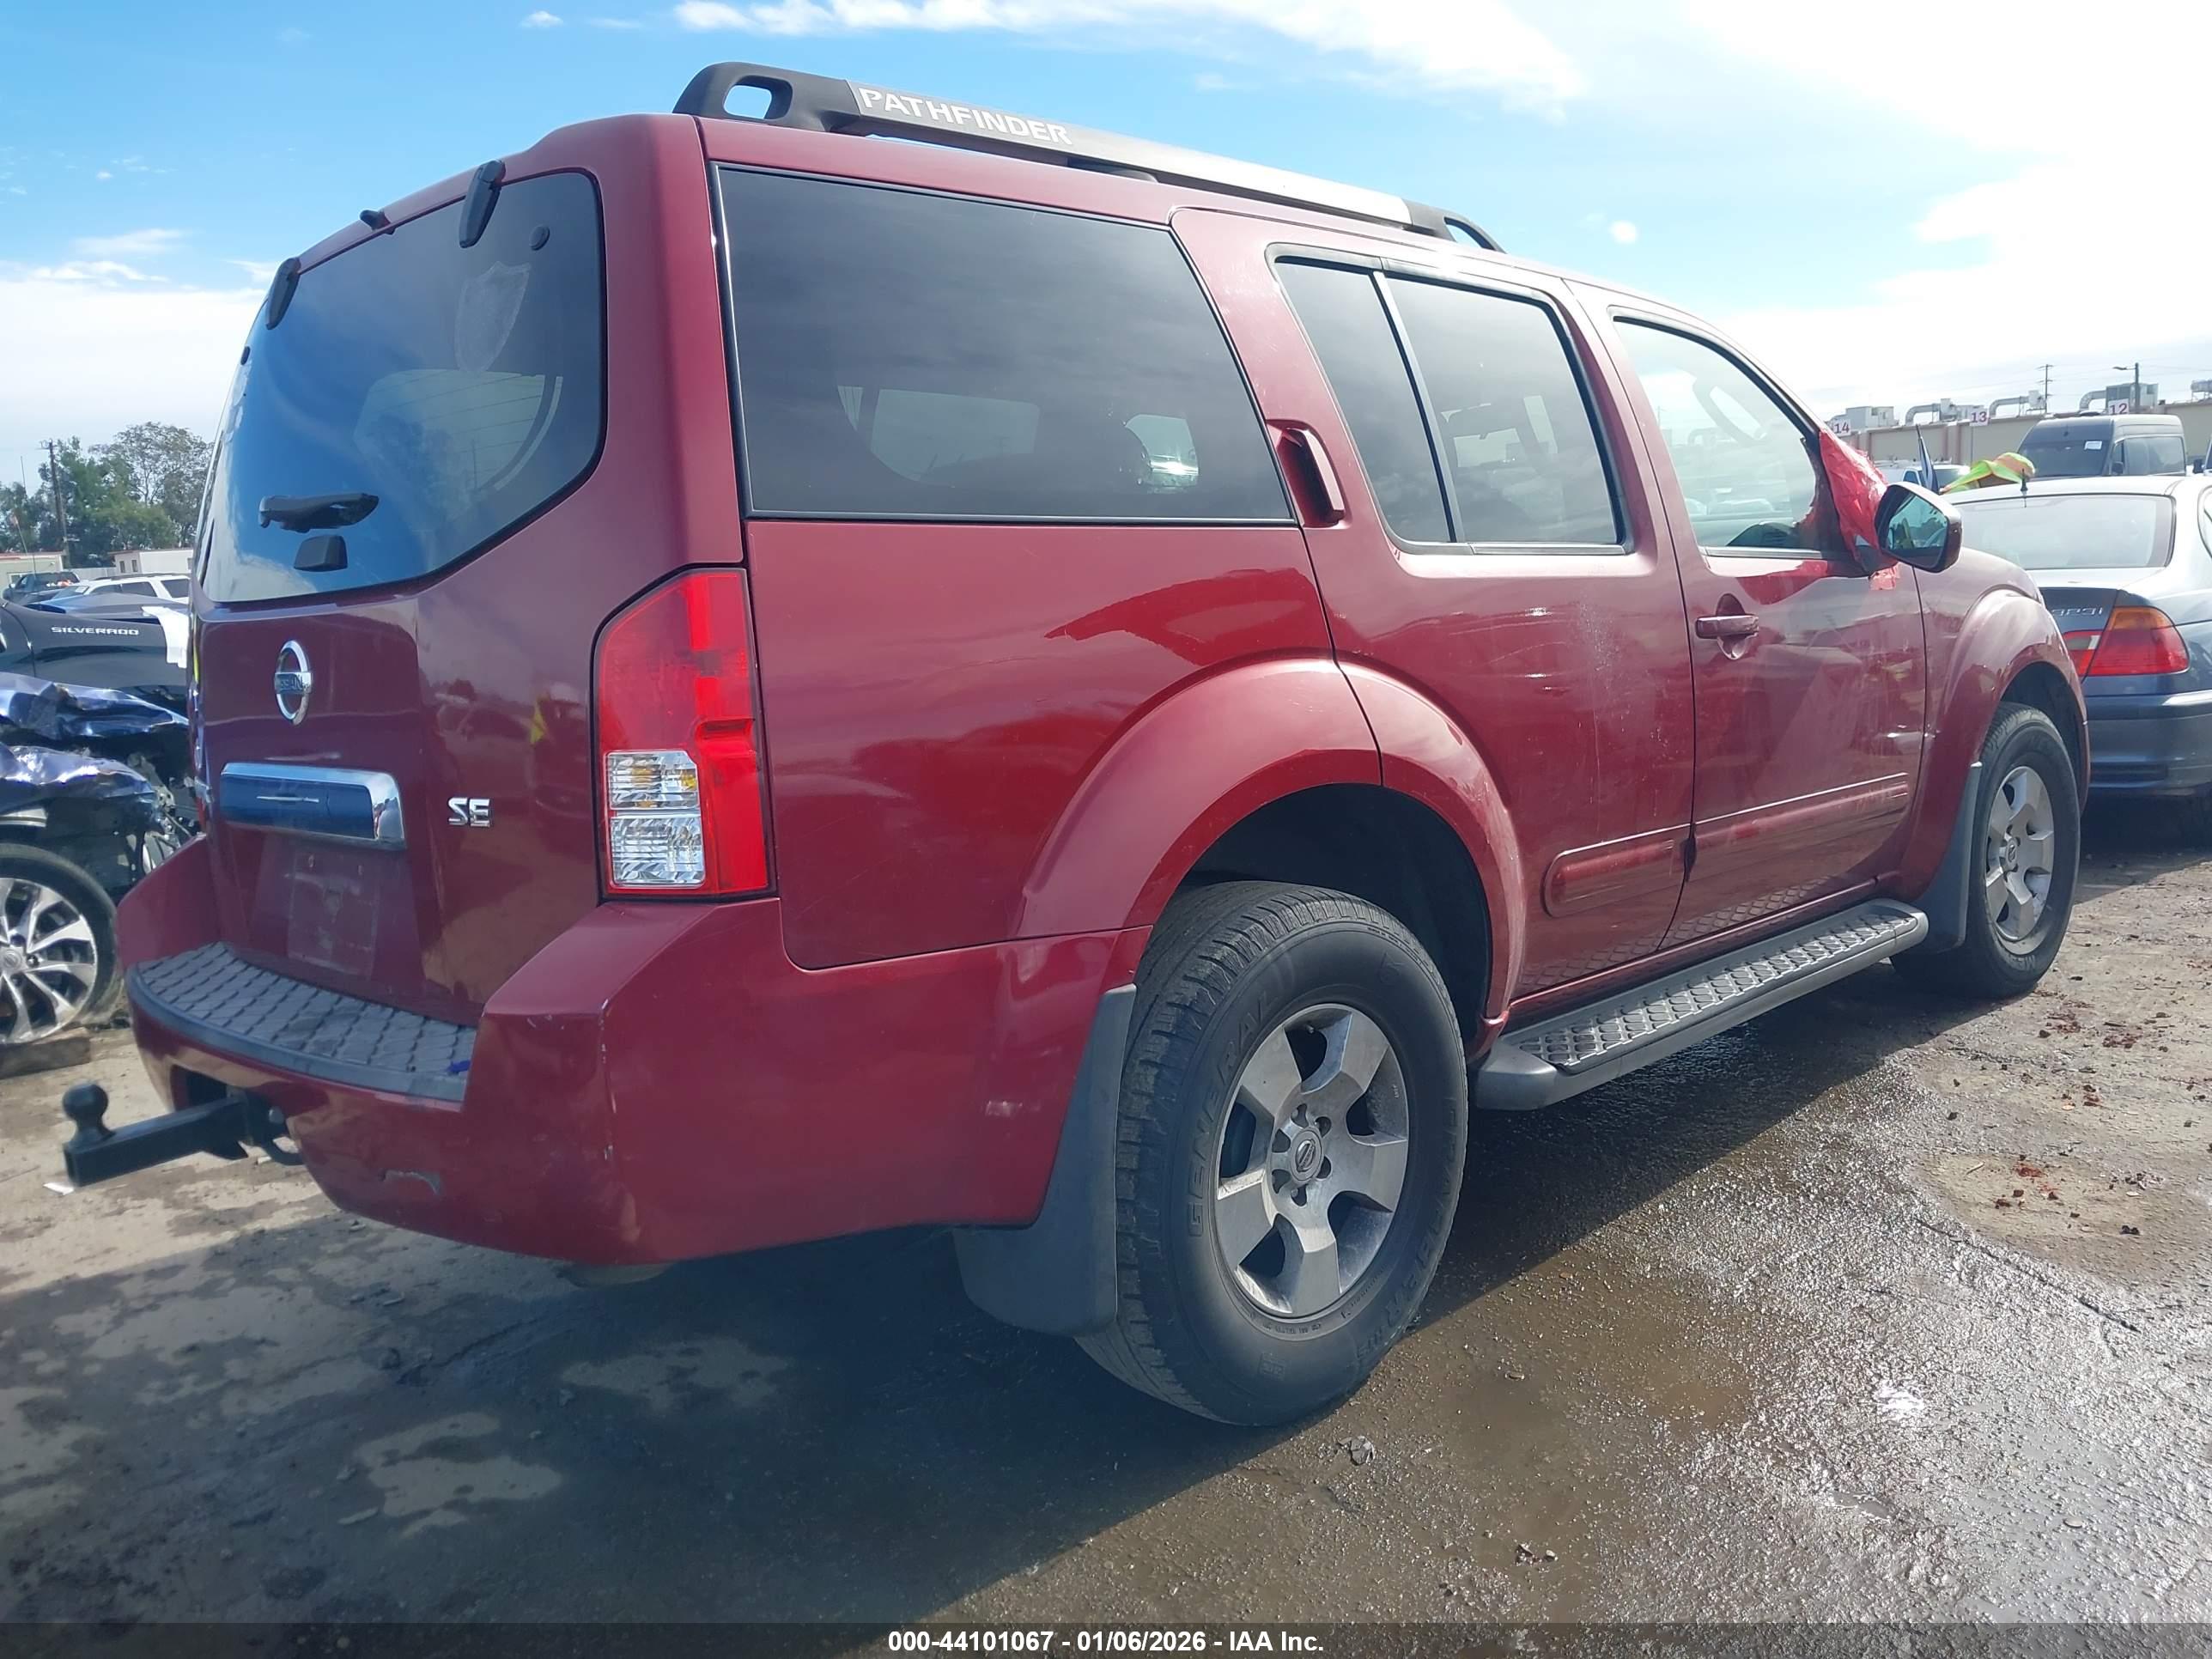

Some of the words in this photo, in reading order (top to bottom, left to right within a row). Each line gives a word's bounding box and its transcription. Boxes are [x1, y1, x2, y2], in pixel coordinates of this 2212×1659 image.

[858, 88, 1073, 144] PATHFINDER
[1971, 410, 1987, 422] 13
[2109, 402, 2128, 416] 12
[1833, 422, 1850, 434] 14
[51, 626, 139, 635] SILVERADO
[447, 797, 490, 827] SE
[1188, 989, 1278, 1237] GENERAL
